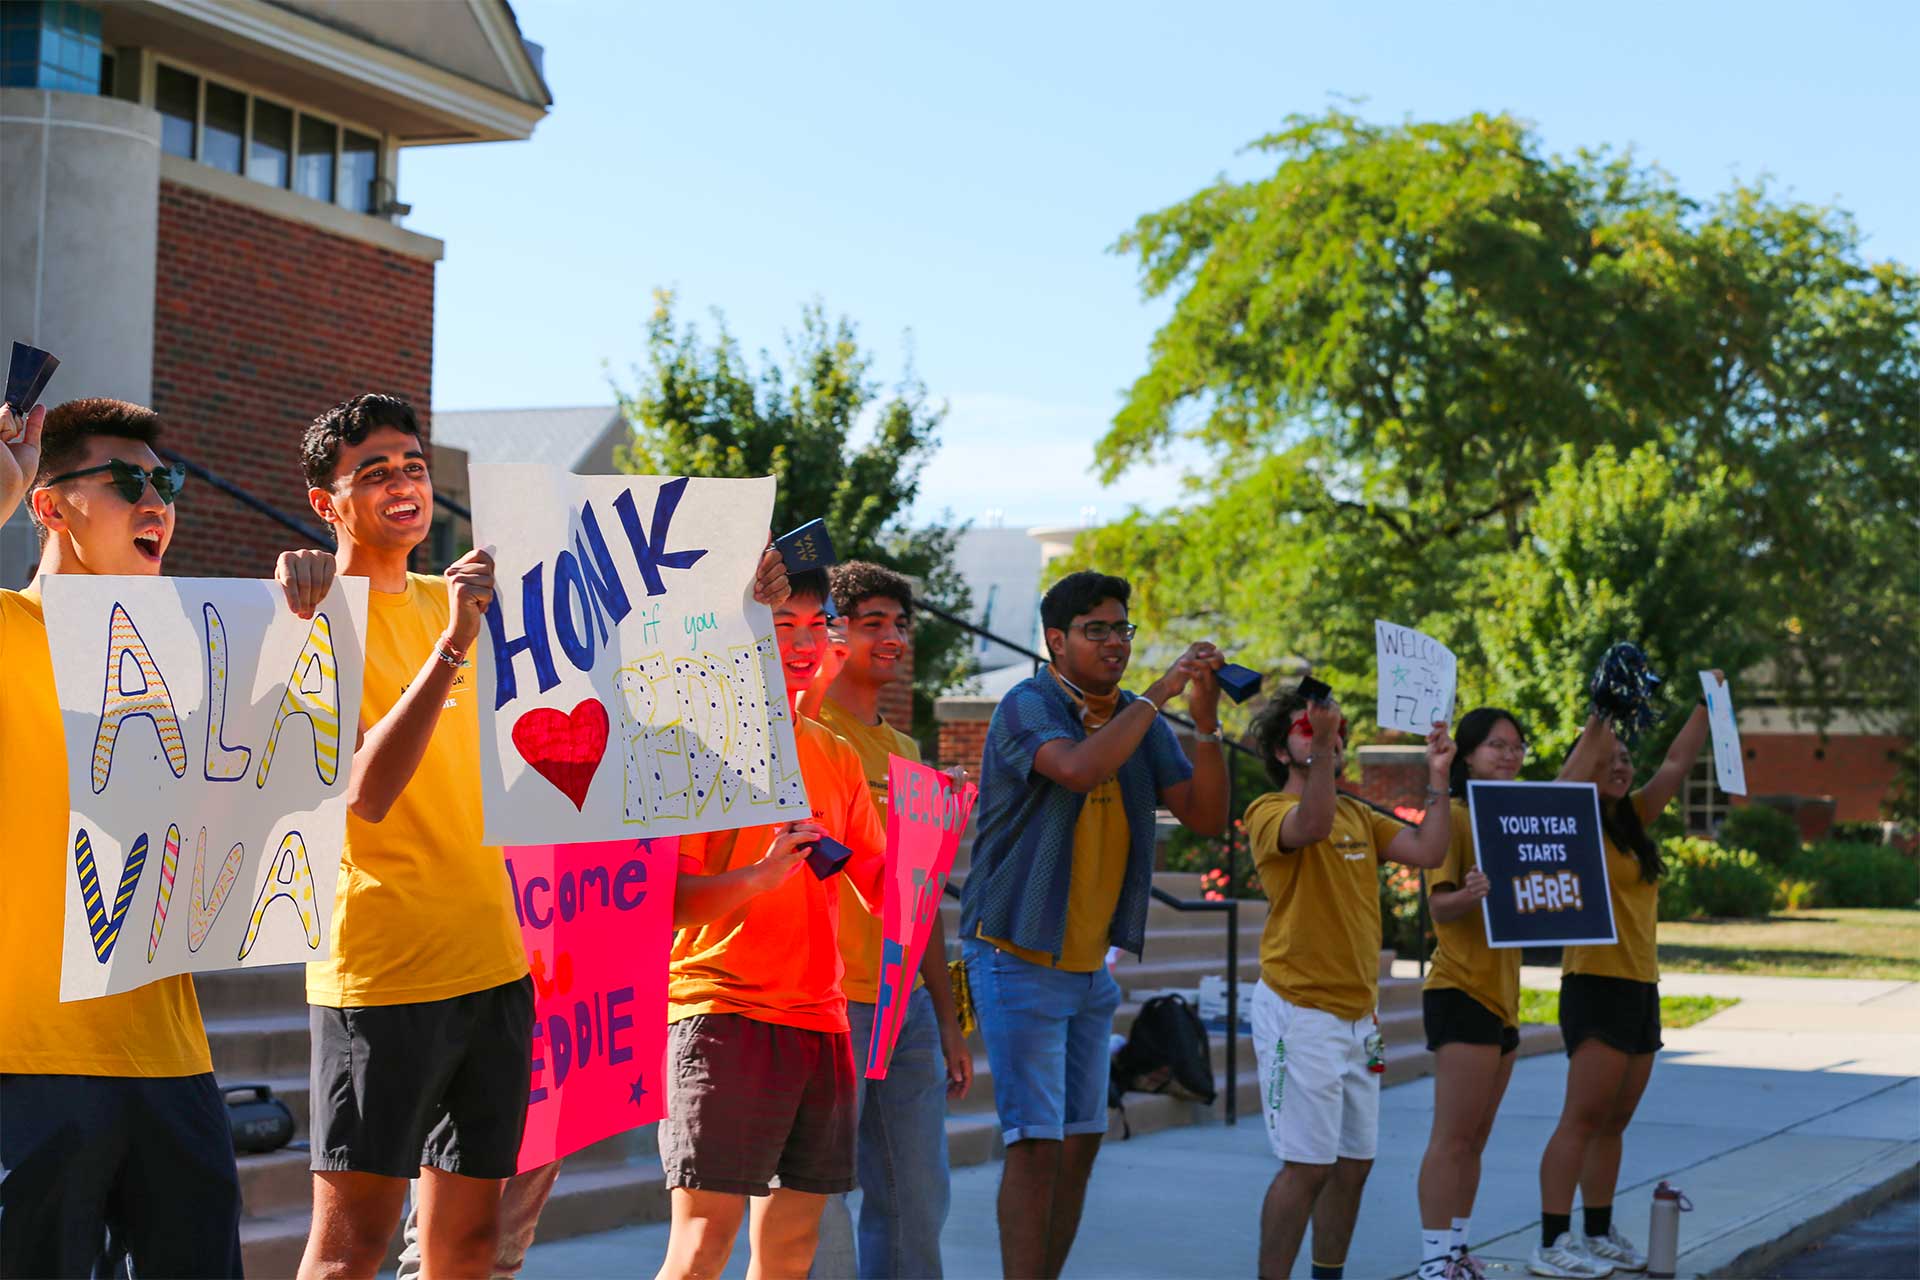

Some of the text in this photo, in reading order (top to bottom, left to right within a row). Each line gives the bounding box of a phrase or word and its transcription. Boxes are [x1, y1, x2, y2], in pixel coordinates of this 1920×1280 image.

[486, 477, 708, 711] HONK
[641, 603, 719, 650] if you
[91, 601, 340, 794] ALA
[1500, 816, 1577, 834] YOUR YEAR
[1518, 843, 1567, 862] STARTS
[75, 822, 321, 964] VIVA
[505, 859, 648, 929] lcome
[1513, 870, 1583, 913] HERE!
[532, 950, 573, 999] to
[529, 986, 634, 1105] EDDIE
